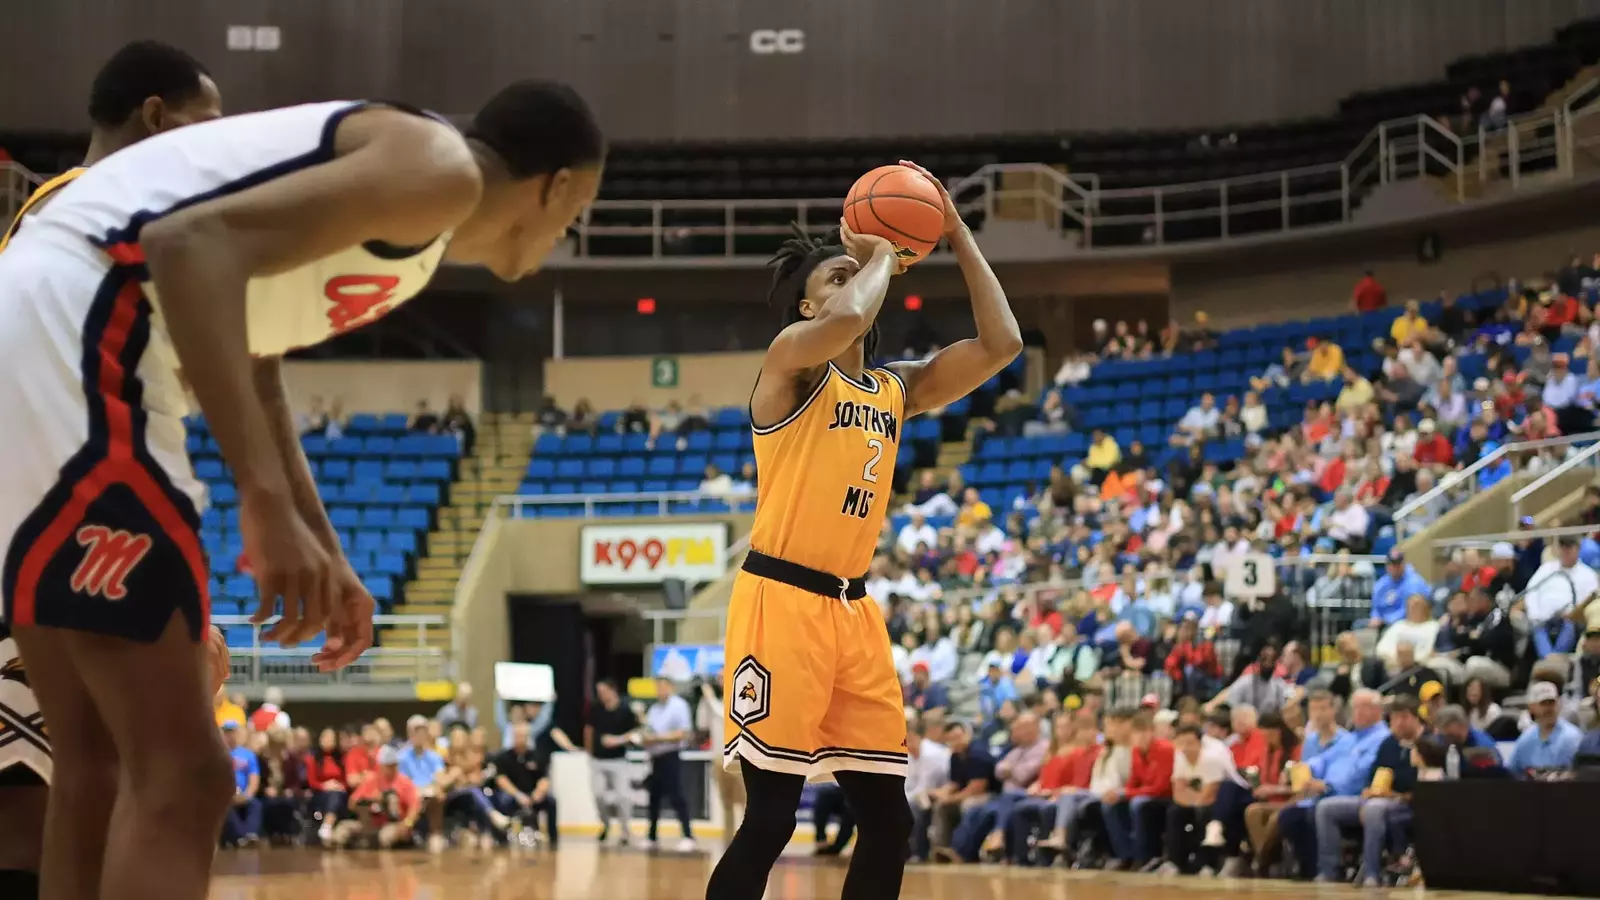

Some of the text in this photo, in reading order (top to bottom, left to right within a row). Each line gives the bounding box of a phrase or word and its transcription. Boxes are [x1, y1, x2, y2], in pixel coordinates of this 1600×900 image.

[750, 28, 805, 54] CC
[861, 438, 883, 484] 2
[1243, 561, 1257, 586] 3
